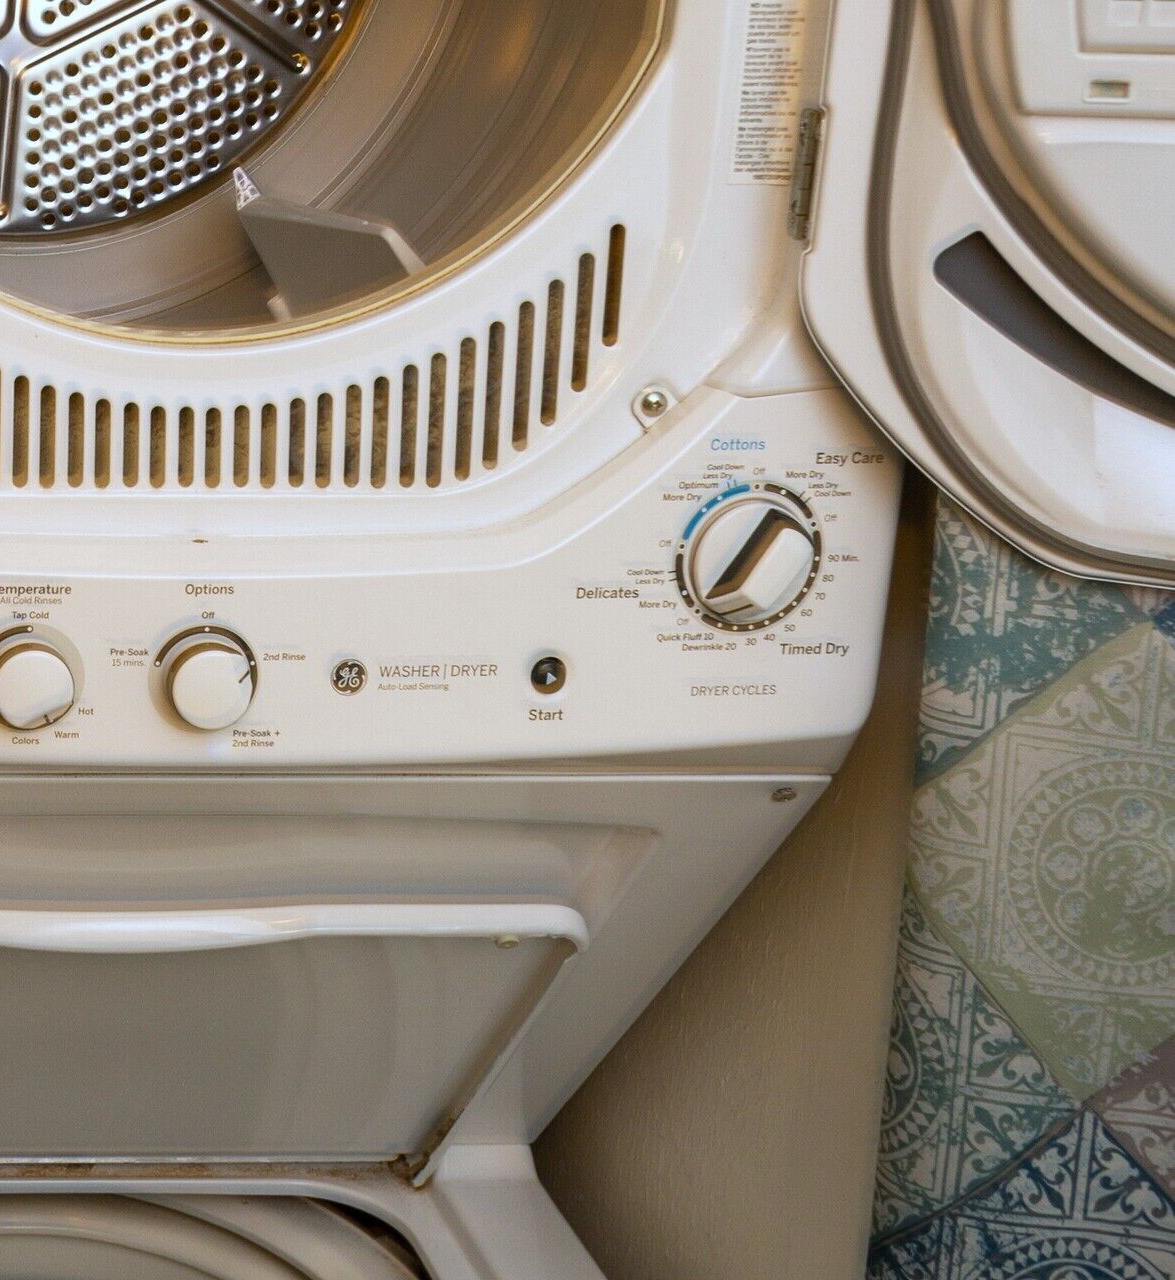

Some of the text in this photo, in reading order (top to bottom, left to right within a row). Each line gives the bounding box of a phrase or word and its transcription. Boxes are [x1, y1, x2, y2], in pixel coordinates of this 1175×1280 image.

[711, 439, 765, 450] Cottons
[816, 453, 883, 466] Easy Care
[753, 467, 765, 475] Off
[808, 471, 824, 480] Dry
[718, 472, 733, 480] Dry
[679, 481, 718, 490] Optimum
[824, 482, 838, 490] Dry
[685, 494, 702, 502] Dry
[824, 513, 837, 522] Off
[659, 539, 671, 548] Off
[185, 584, 234, 596] Options
[576, 588, 639, 599] Delicates
[661, 601, 677, 609] Dry
[13, 612, 26, 620] Tap
[801, 609, 812, 617] 60
[677, 618, 689, 626] Off
[784, 624, 795, 632] 50
[657, 634, 680, 642] Quick
[683, 633, 701, 641] Fluff
[745, 638, 756, 646] 30
[682, 643, 723, 651] Dewrinkle
[780, 643, 849, 656] Timed Dry
[380, 665, 497, 677] WASHER DRYER
[419, 682, 449, 691] Sensing
[691, 685, 777, 696] DRYER CYCLES
[529, 709, 563, 720] Start
